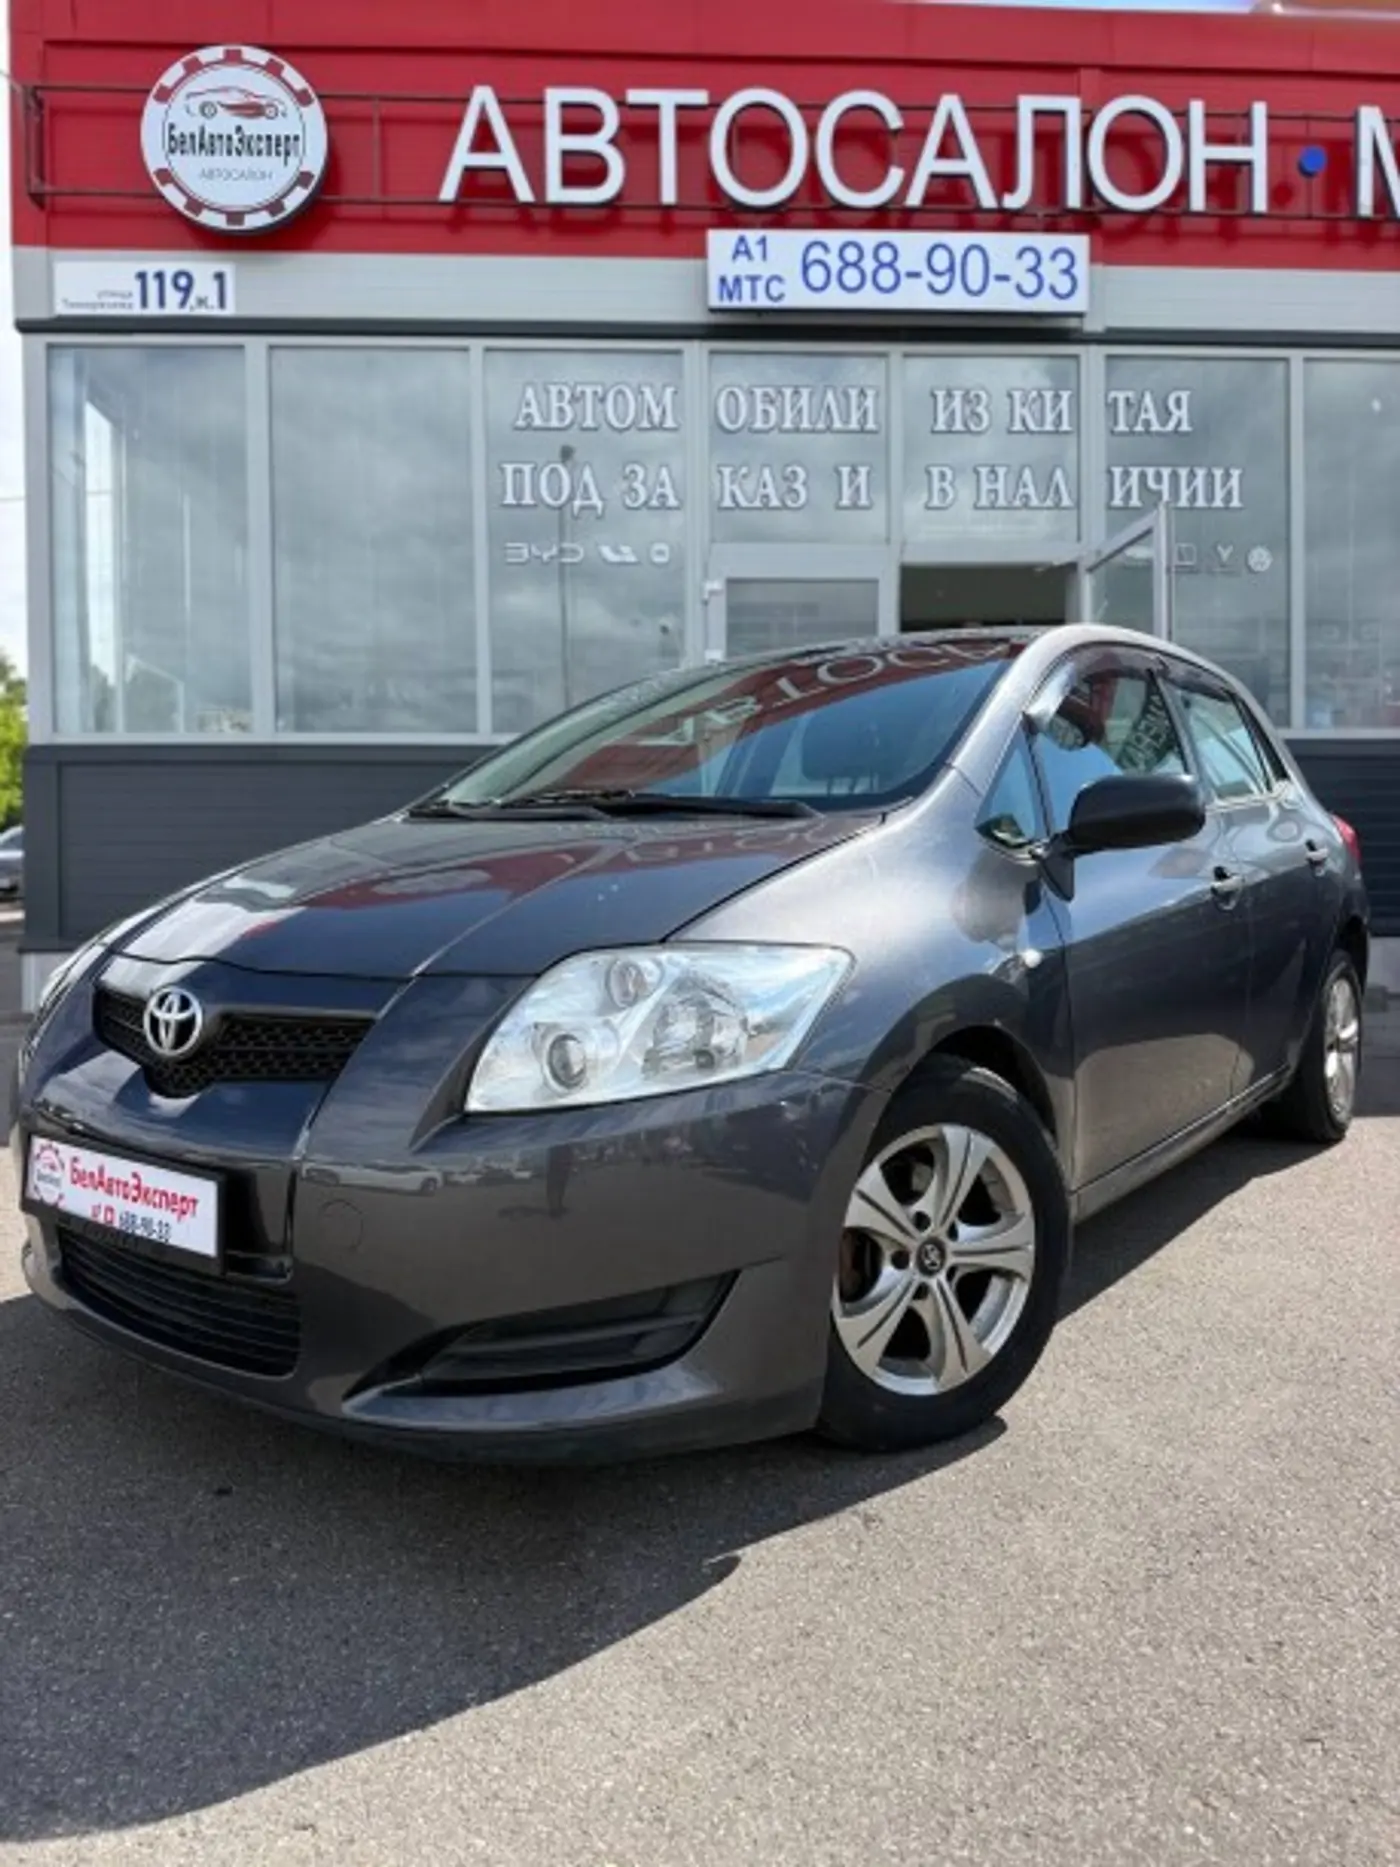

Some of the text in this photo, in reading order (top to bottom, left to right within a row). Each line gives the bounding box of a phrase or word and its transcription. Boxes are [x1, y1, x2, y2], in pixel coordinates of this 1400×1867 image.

[167, 123, 301, 166] БелАвтоЭксперт
[438, 85, 1268, 213] АВТОСАЛОН
[199, 167, 273, 181] АВТОСАЛОН
[717, 274, 787, 302] МТС
[801, 239, 1079, 300] 688-90-33
[514, 384, 1193, 432] АВТОМ ОБИЛИ ИЗ КИ ТАЯ
[501, 463, 1244, 517] ПОД ЗА КАЗ И В НАЛ ИЧИИ
[70, 1157, 199, 1222] БелАвтоЭксперт
